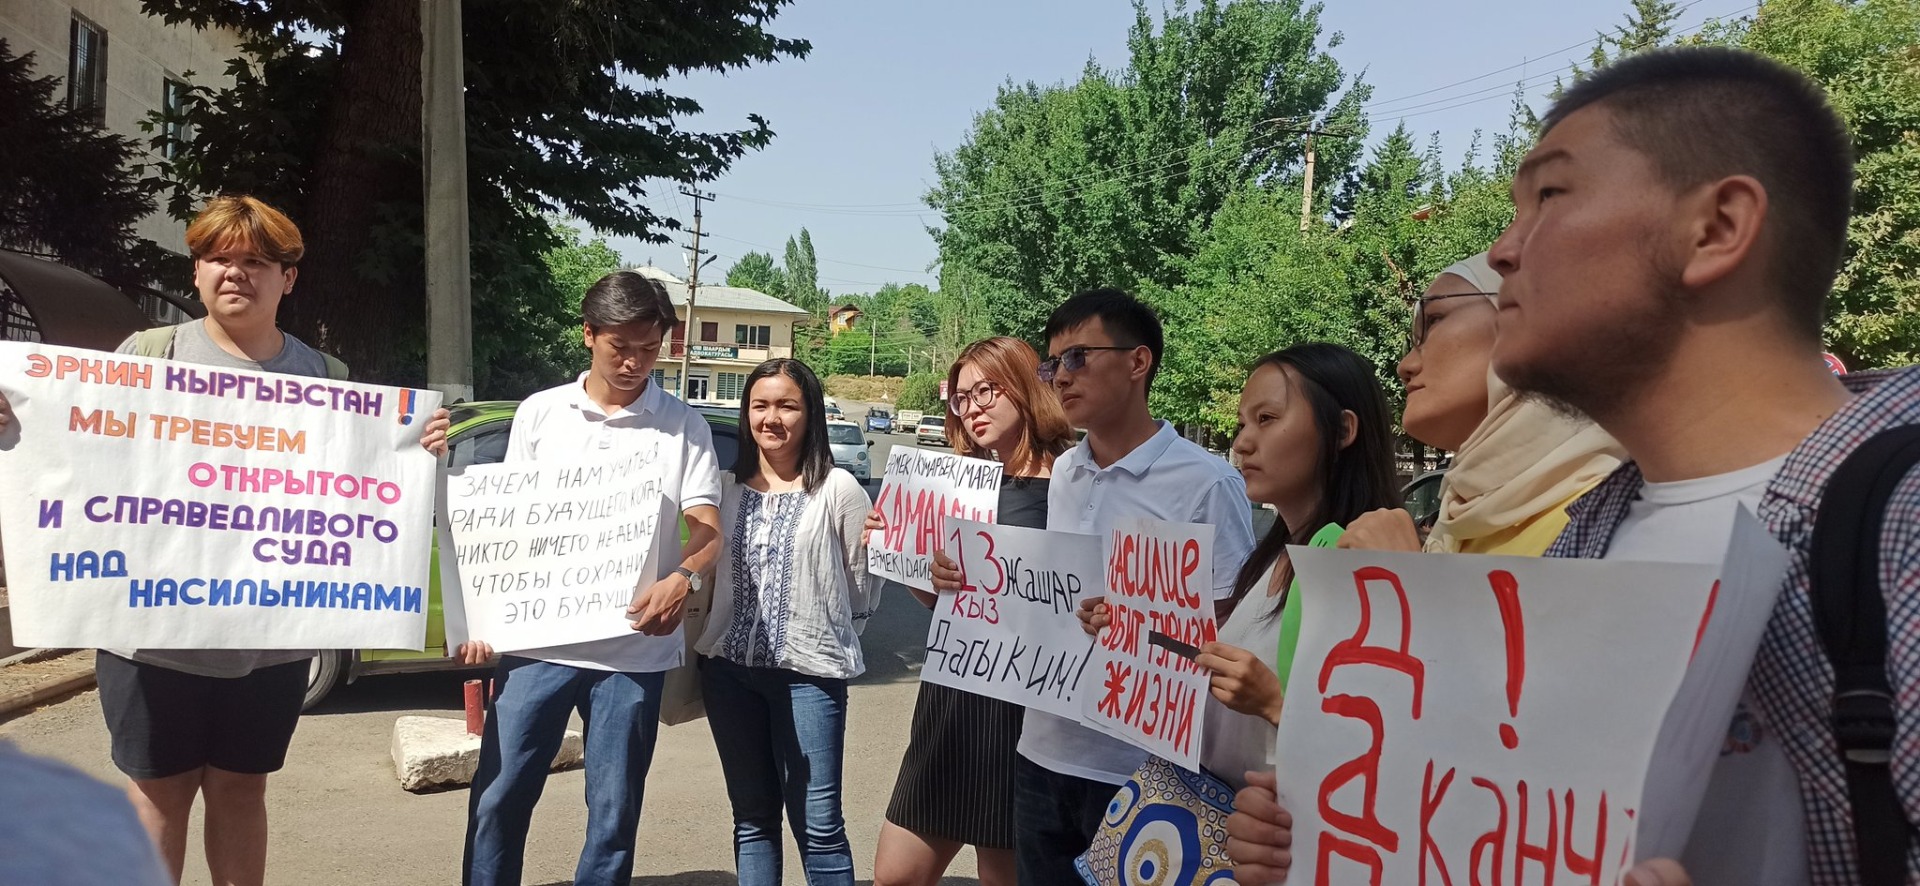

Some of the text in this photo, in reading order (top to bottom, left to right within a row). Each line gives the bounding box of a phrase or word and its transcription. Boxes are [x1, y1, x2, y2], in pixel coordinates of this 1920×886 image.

[25, 353, 152, 389] ЭРКИН
[165, 366, 383, 417] КЫРГЫЗСТАН
[68, 406, 306, 454] МЫ ТРЕБУЕМ
[187, 462, 402, 505] ОТКРЫТОГО
[460, 471, 540, 497] ЗАЧЕМ
[556, 466, 603, 489] НАМ
[959, 463, 1003, 491] МАРАТ
[38, 495, 399, 544] И СПРАВЕДЛИВОГО
[448, 506, 516, 532] РАДИ
[252, 537, 352, 567] СУДА
[456, 540, 518, 566] НИКТО
[528, 534, 590, 558] НИЧЕГО
[616, 513, 659, 543] ДЕЛАЕ
[50, 549, 129, 582] НАД
[472, 549, 650, 597] ЧТОБЫ СОХРАНИ
[870, 547, 901, 576] ЭРМЕК
[950, 527, 1004, 594] 13
[128, 577, 423, 613] НАСИЛЬНИКАМИ
[504, 598, 546, 624] ЭТО
[951, 592, 999, 624] КЫЗ
[1102, 603, 1145, 657] УБИТ
[1098, 660, 1197, 757] ЖИЗНИ
